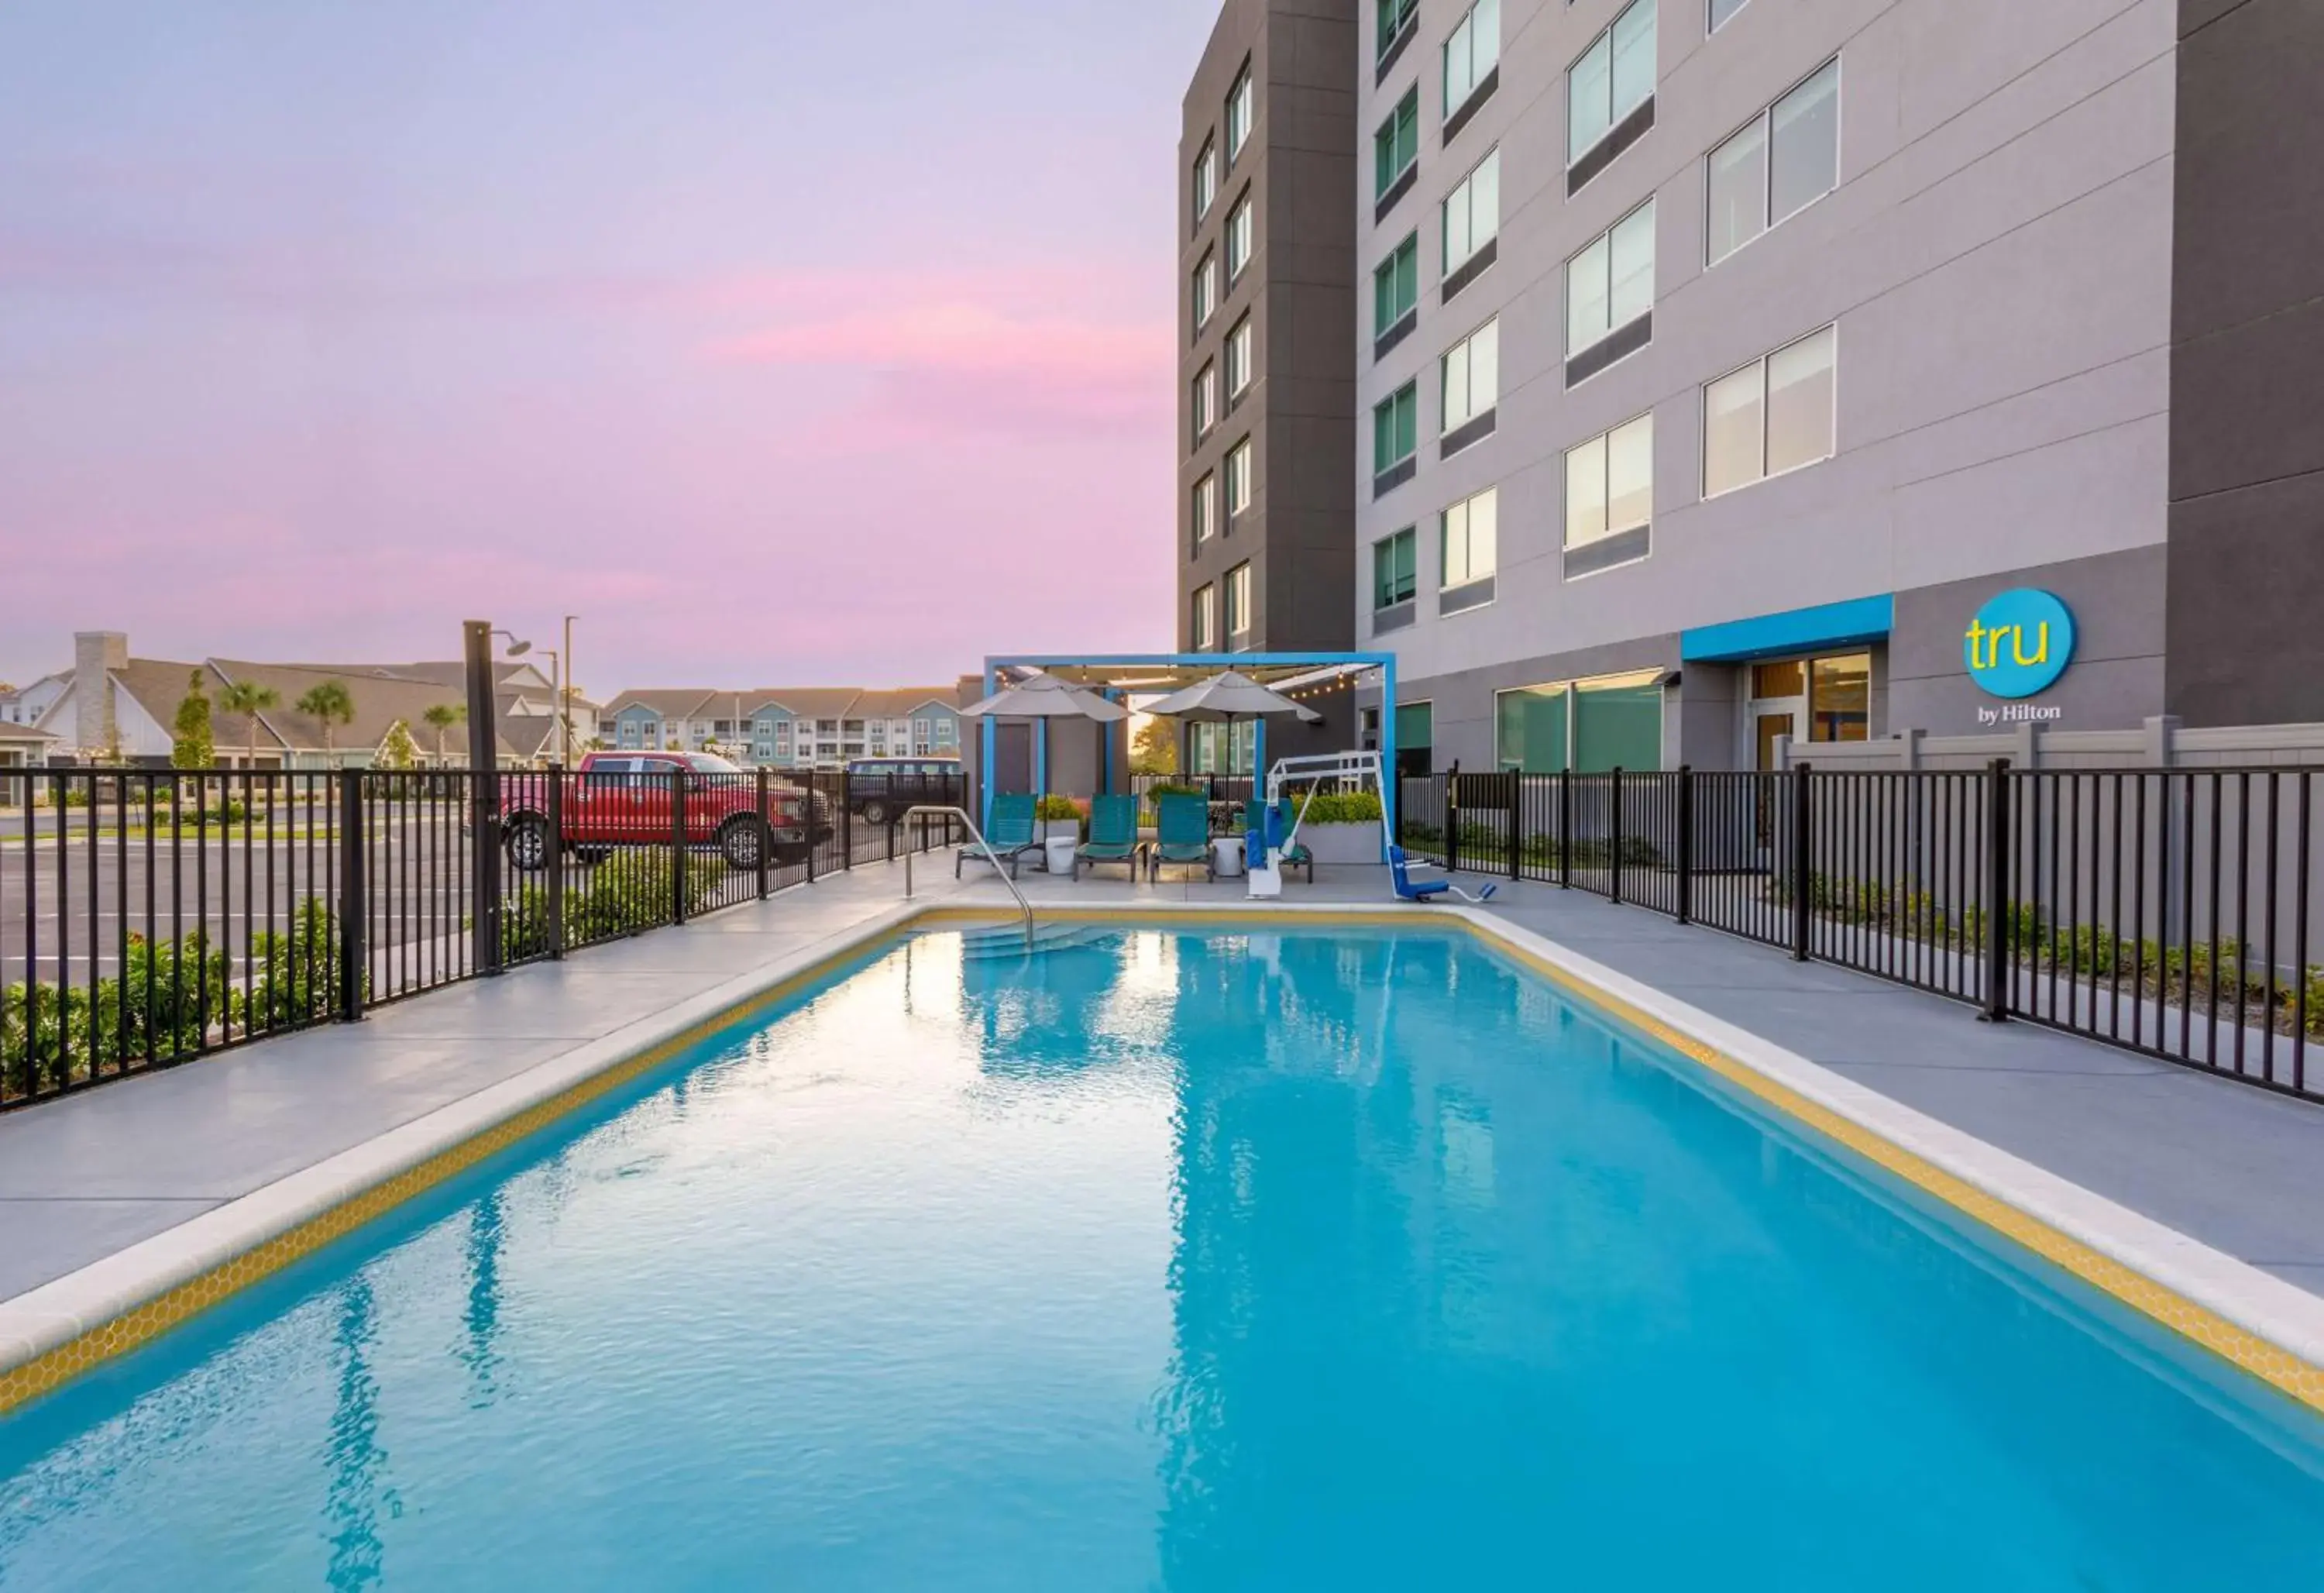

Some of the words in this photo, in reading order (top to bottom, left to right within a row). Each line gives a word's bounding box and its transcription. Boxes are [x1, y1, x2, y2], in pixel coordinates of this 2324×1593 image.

[1965, 619, 2048, 669] tru
[1978, 707, 1999, 725] by
[2003, 704, 2061, 721] Hilton
